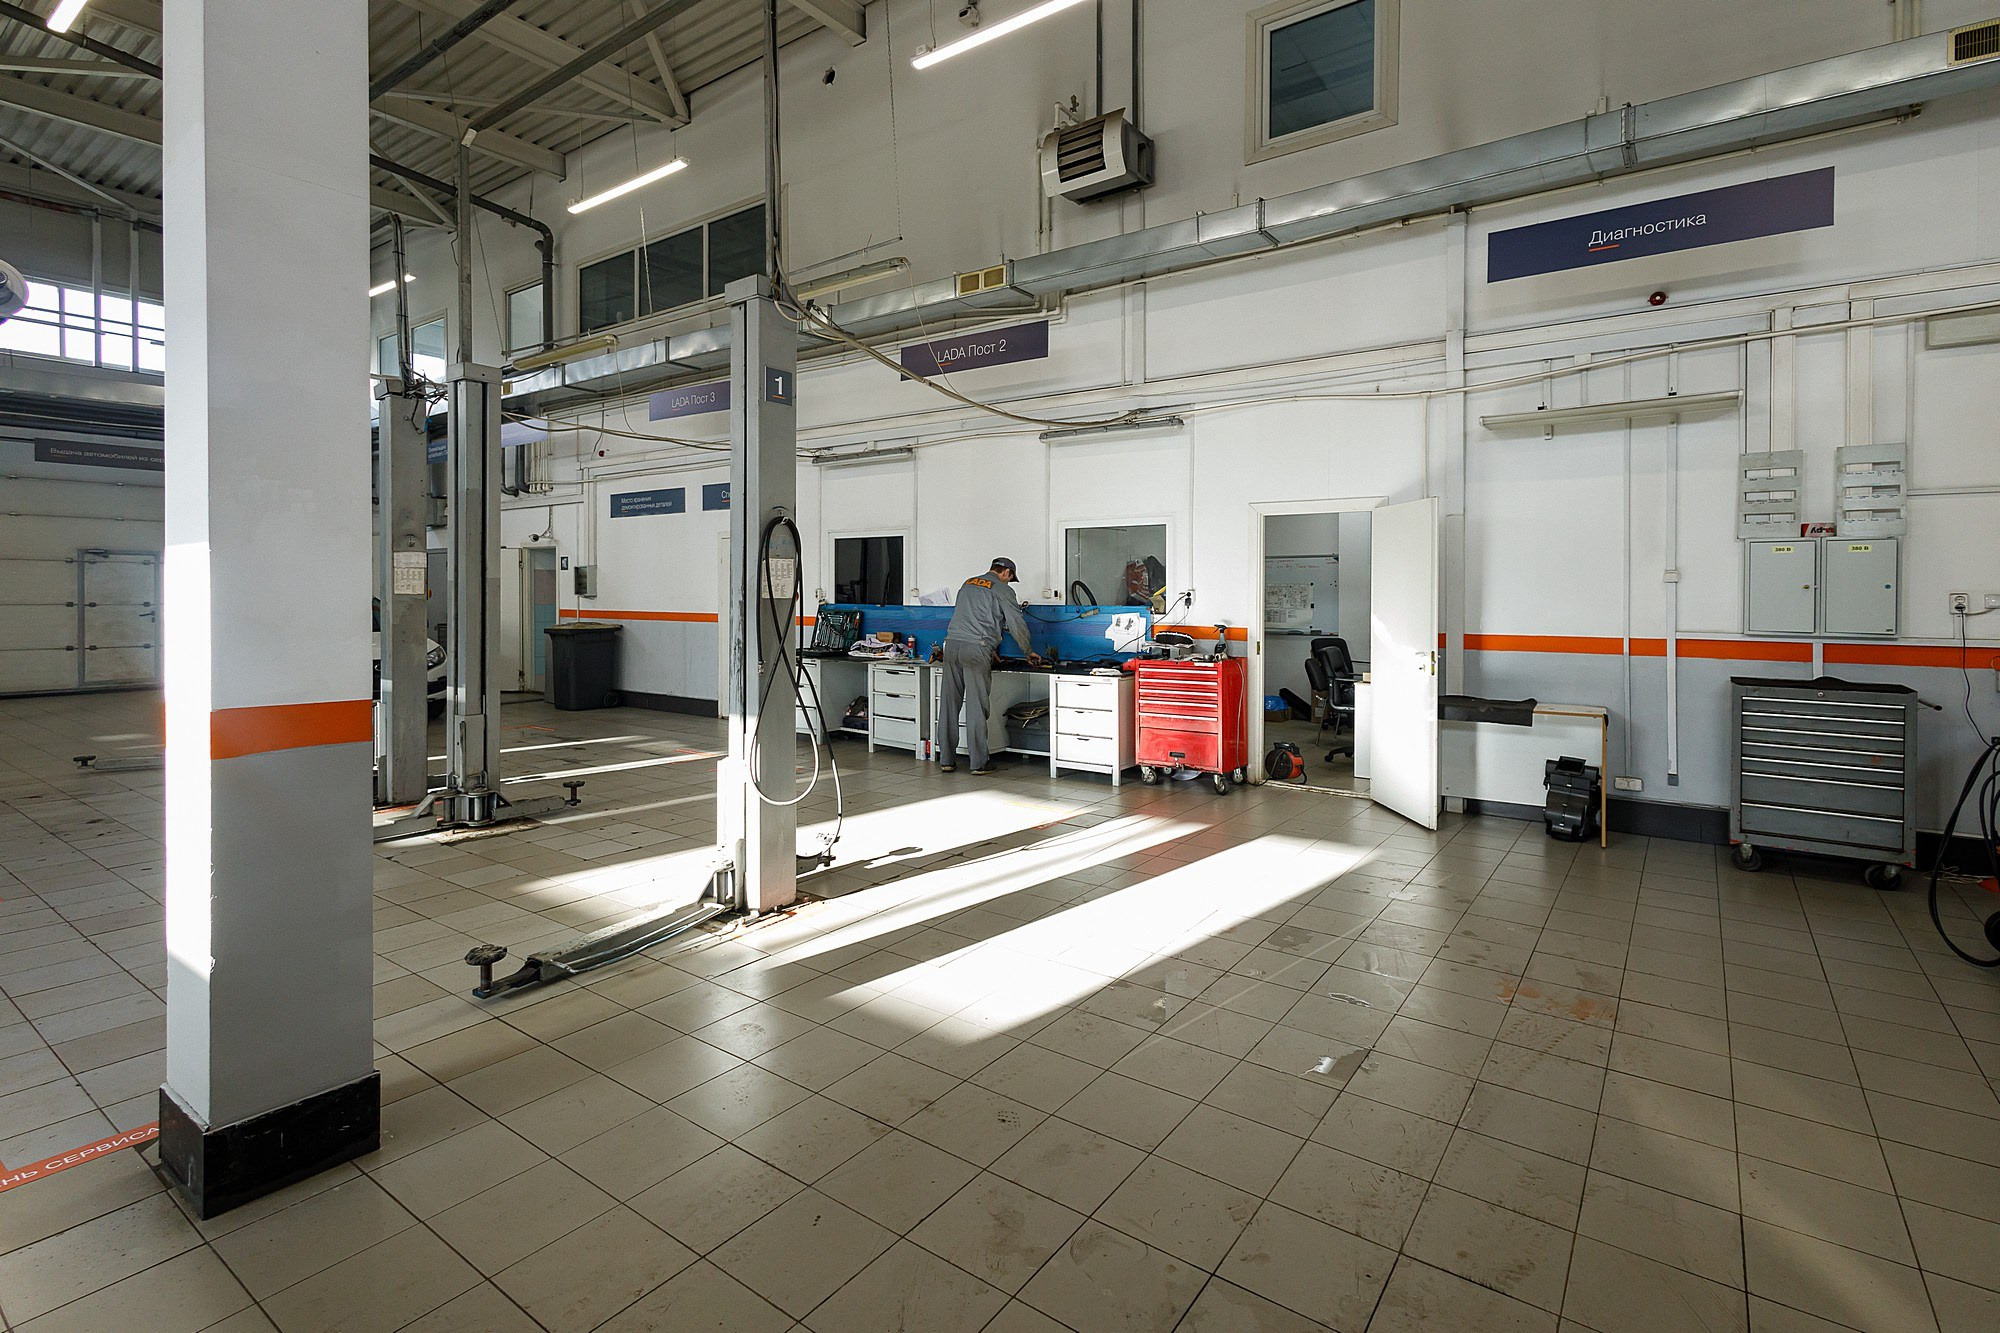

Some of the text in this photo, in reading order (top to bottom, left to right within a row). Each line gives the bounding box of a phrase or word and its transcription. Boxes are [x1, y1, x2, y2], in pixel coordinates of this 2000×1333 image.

[1588, 213, 1707, 247] Диагностика
[937, 338, 1007, 363] LADA Пост 2
[774, 376, 783, 395] 1
[671, 391, 716, 408] LADA Пост 3
[50, 447, 82, 456] Выдача
[83, 451, 138, 461] автомобилей
[965, 577, 992, 589] LADA
[0, 1127, 160, 1188] НЬ СЕРВИСА
